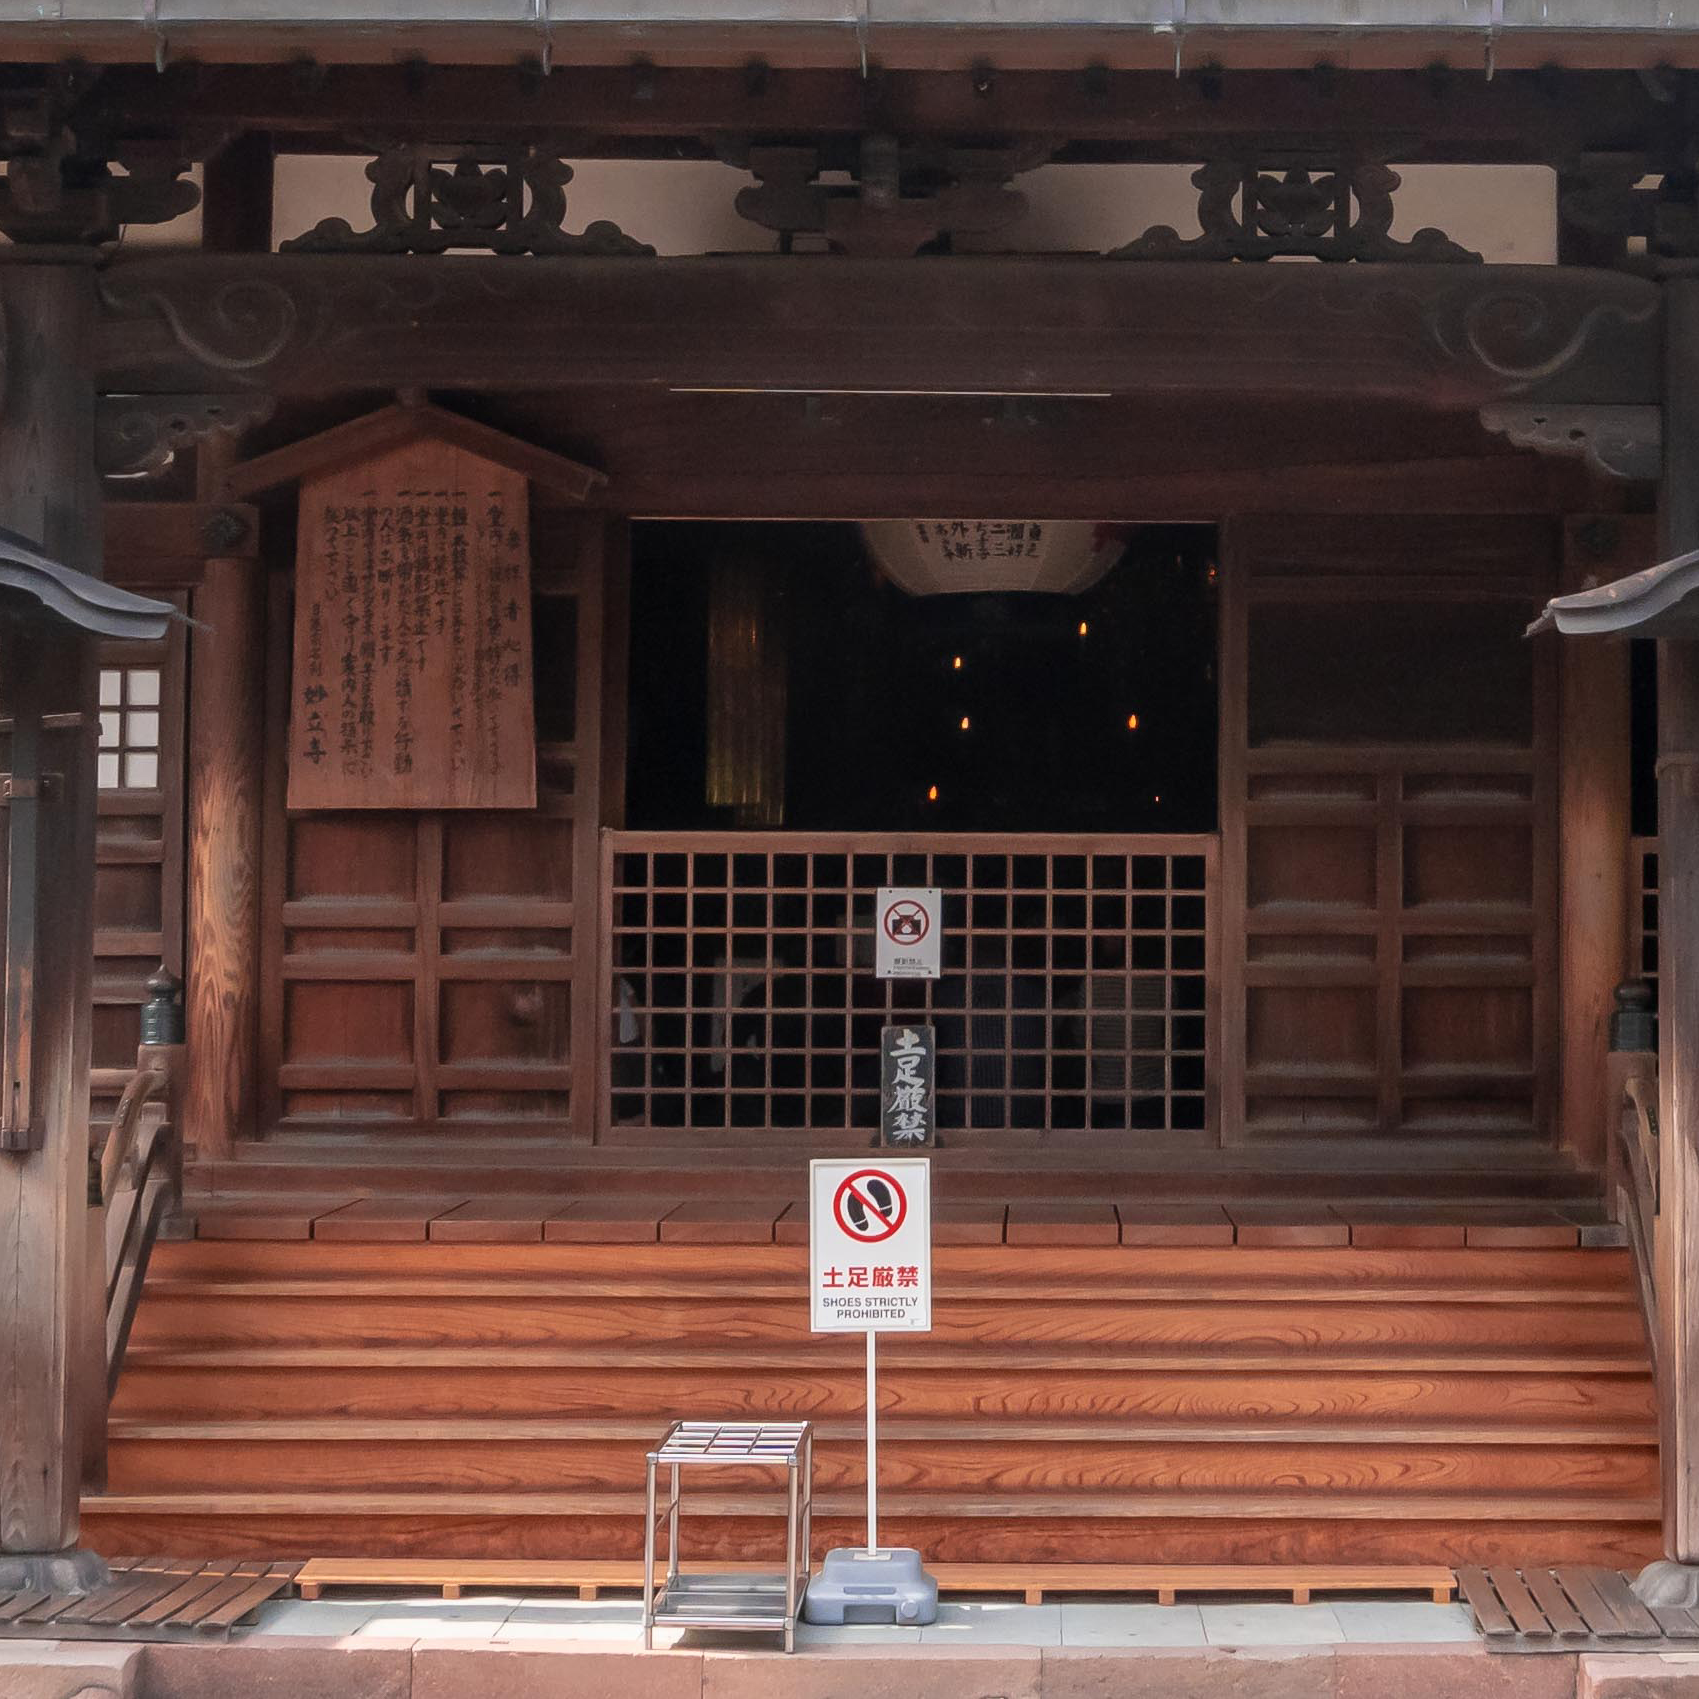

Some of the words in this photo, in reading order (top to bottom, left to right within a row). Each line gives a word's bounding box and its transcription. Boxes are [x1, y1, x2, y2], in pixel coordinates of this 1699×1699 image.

[888, 1028, 928, 1141] 土足厳禁
[822, 1266, 919, 1288] 土足厳禁
[822, 1297, 862, 1308] SHOES
[865, 1297, 918, 1308] STRICTLY
[836, 1309, 906, 1319] PROHIBITED
